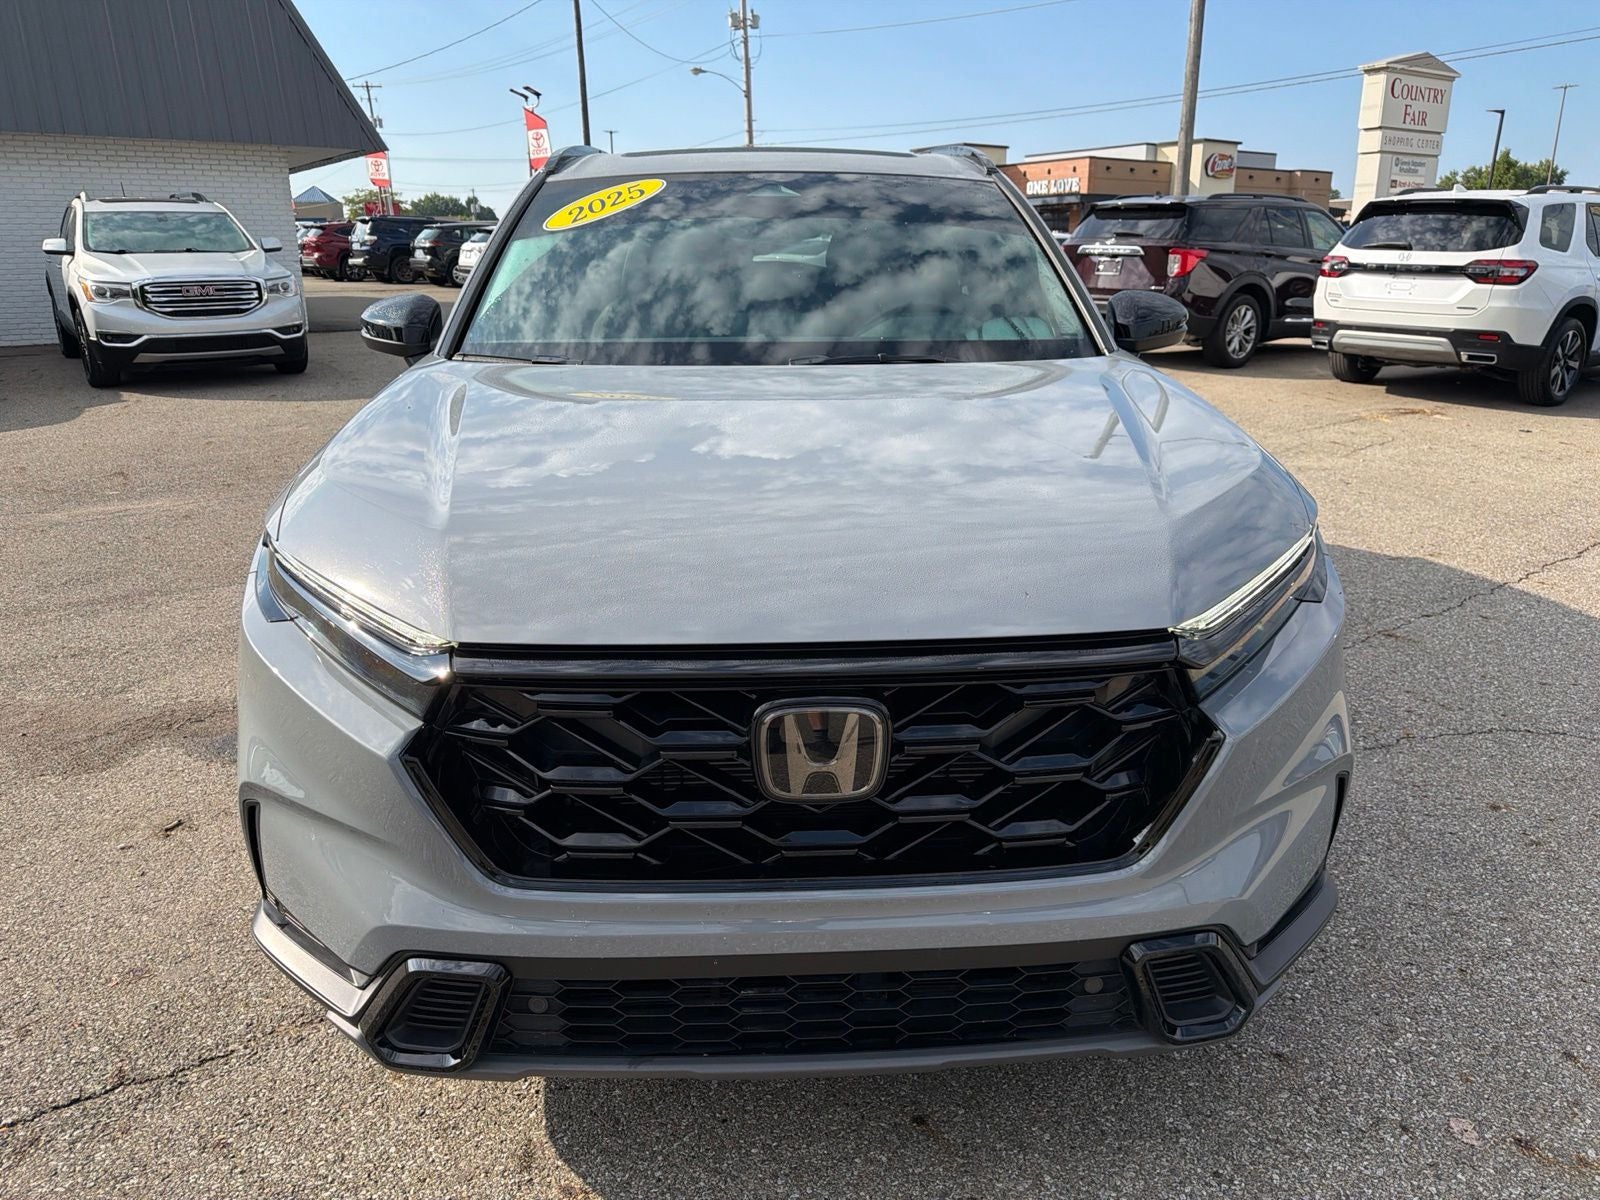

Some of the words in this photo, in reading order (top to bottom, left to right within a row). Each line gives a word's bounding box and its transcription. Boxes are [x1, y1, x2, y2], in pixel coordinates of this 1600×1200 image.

[1391, 77, 1447, 105] COUNTRY
[1402, 104, 1428, 127] FAIR
[1384, 135, 1414, 148] SHOPPING
[1416, 138, 1440, 150] CENTER
[1026, 180, 1049, 195] ONE
[1050, 177, 1080, 194] LOVE
[568, 183, 646, 224] 2025
[181, 285, 225, 297] GMC
